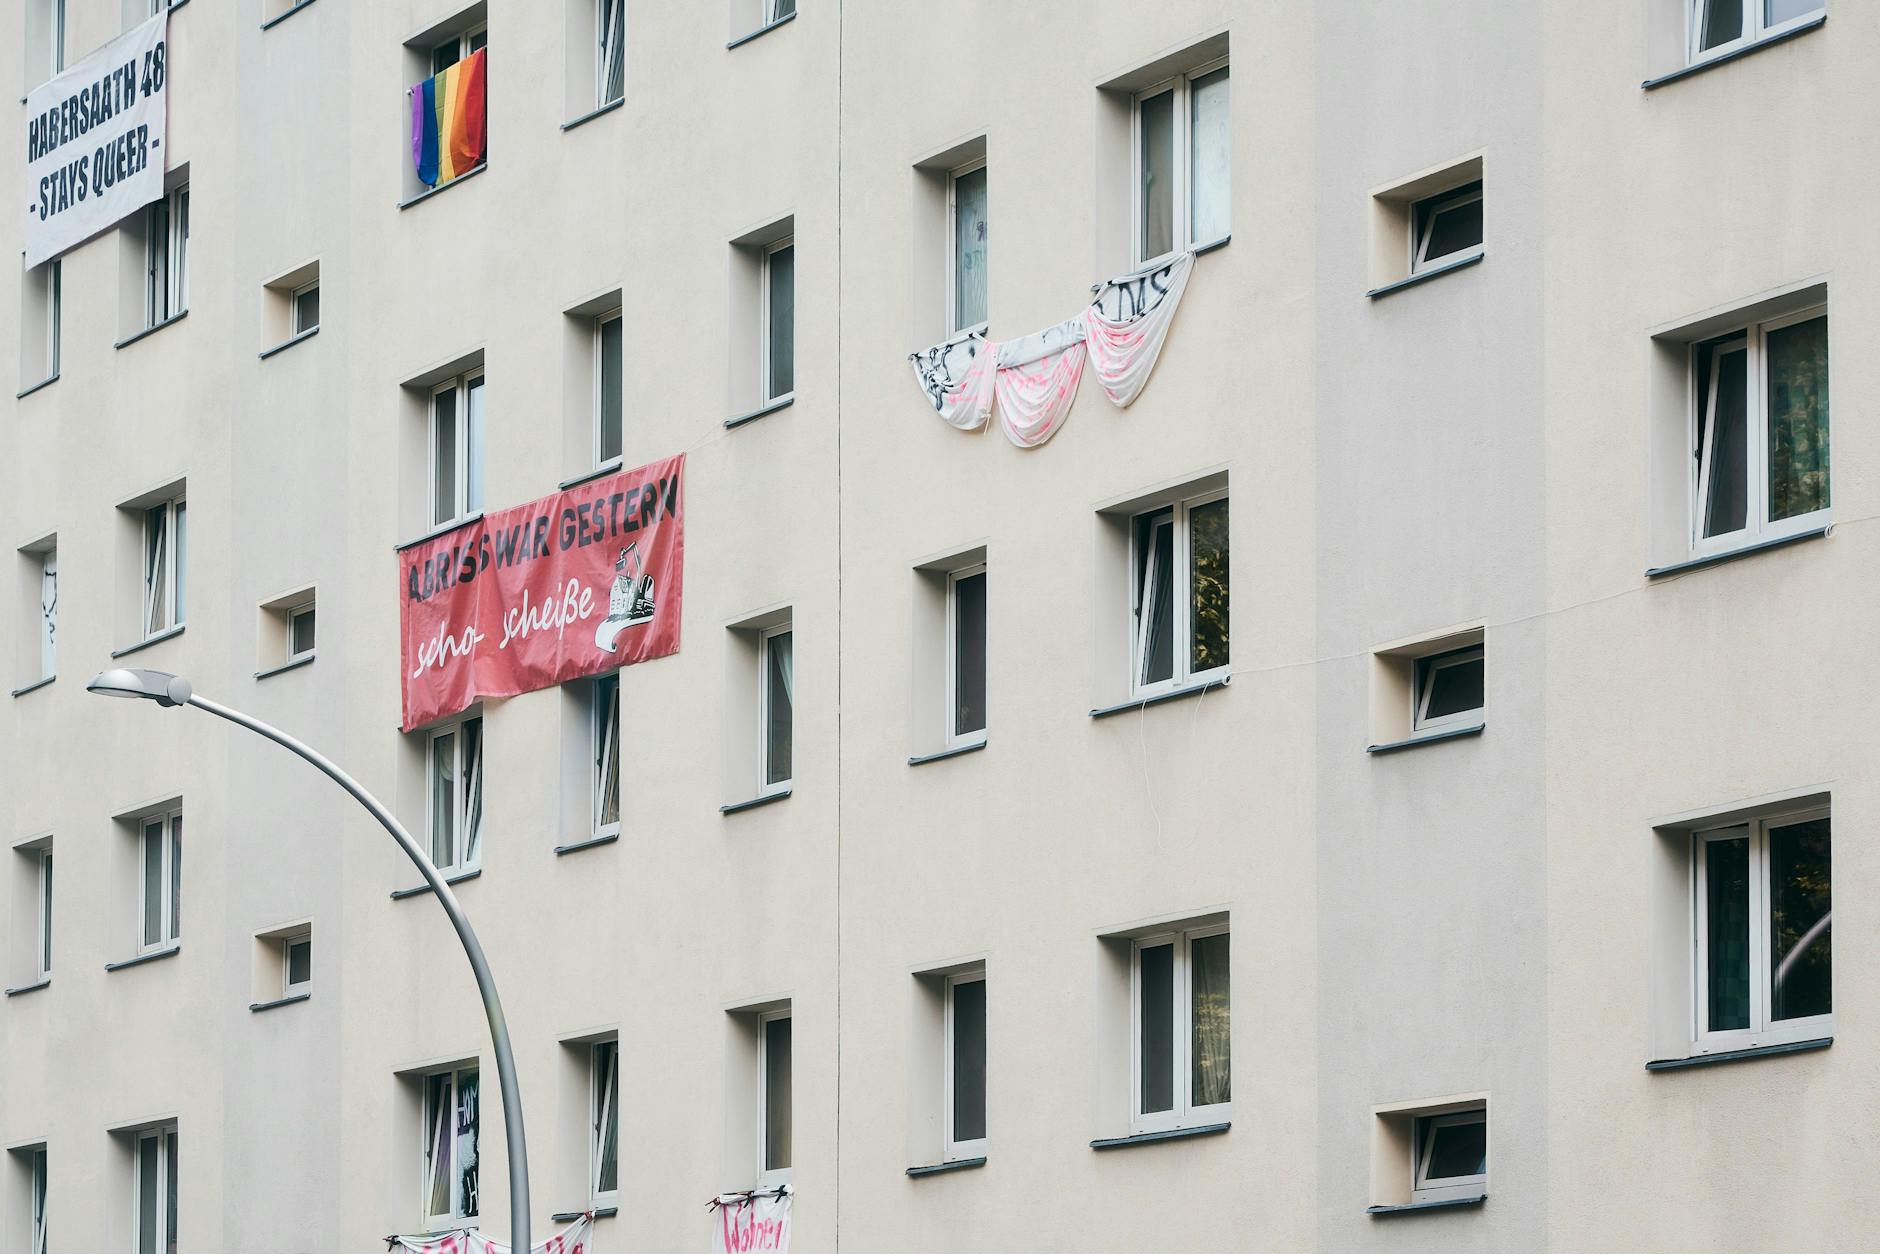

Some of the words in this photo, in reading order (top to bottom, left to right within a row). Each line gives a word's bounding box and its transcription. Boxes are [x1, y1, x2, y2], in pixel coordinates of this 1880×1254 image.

[29, 58, 136, 164] HABERSAATH
[140, 41, 165, 98] 48
[40, 155, 89, 222] STAYS
[92, 123, 148, 197] QUEER
[409, 534, 490, 603] ABRISS
[495, 516, 550, 570] WAR
[560, 474, 678, 551] GESTERN
[500, 578, 595, 649] scheiße
